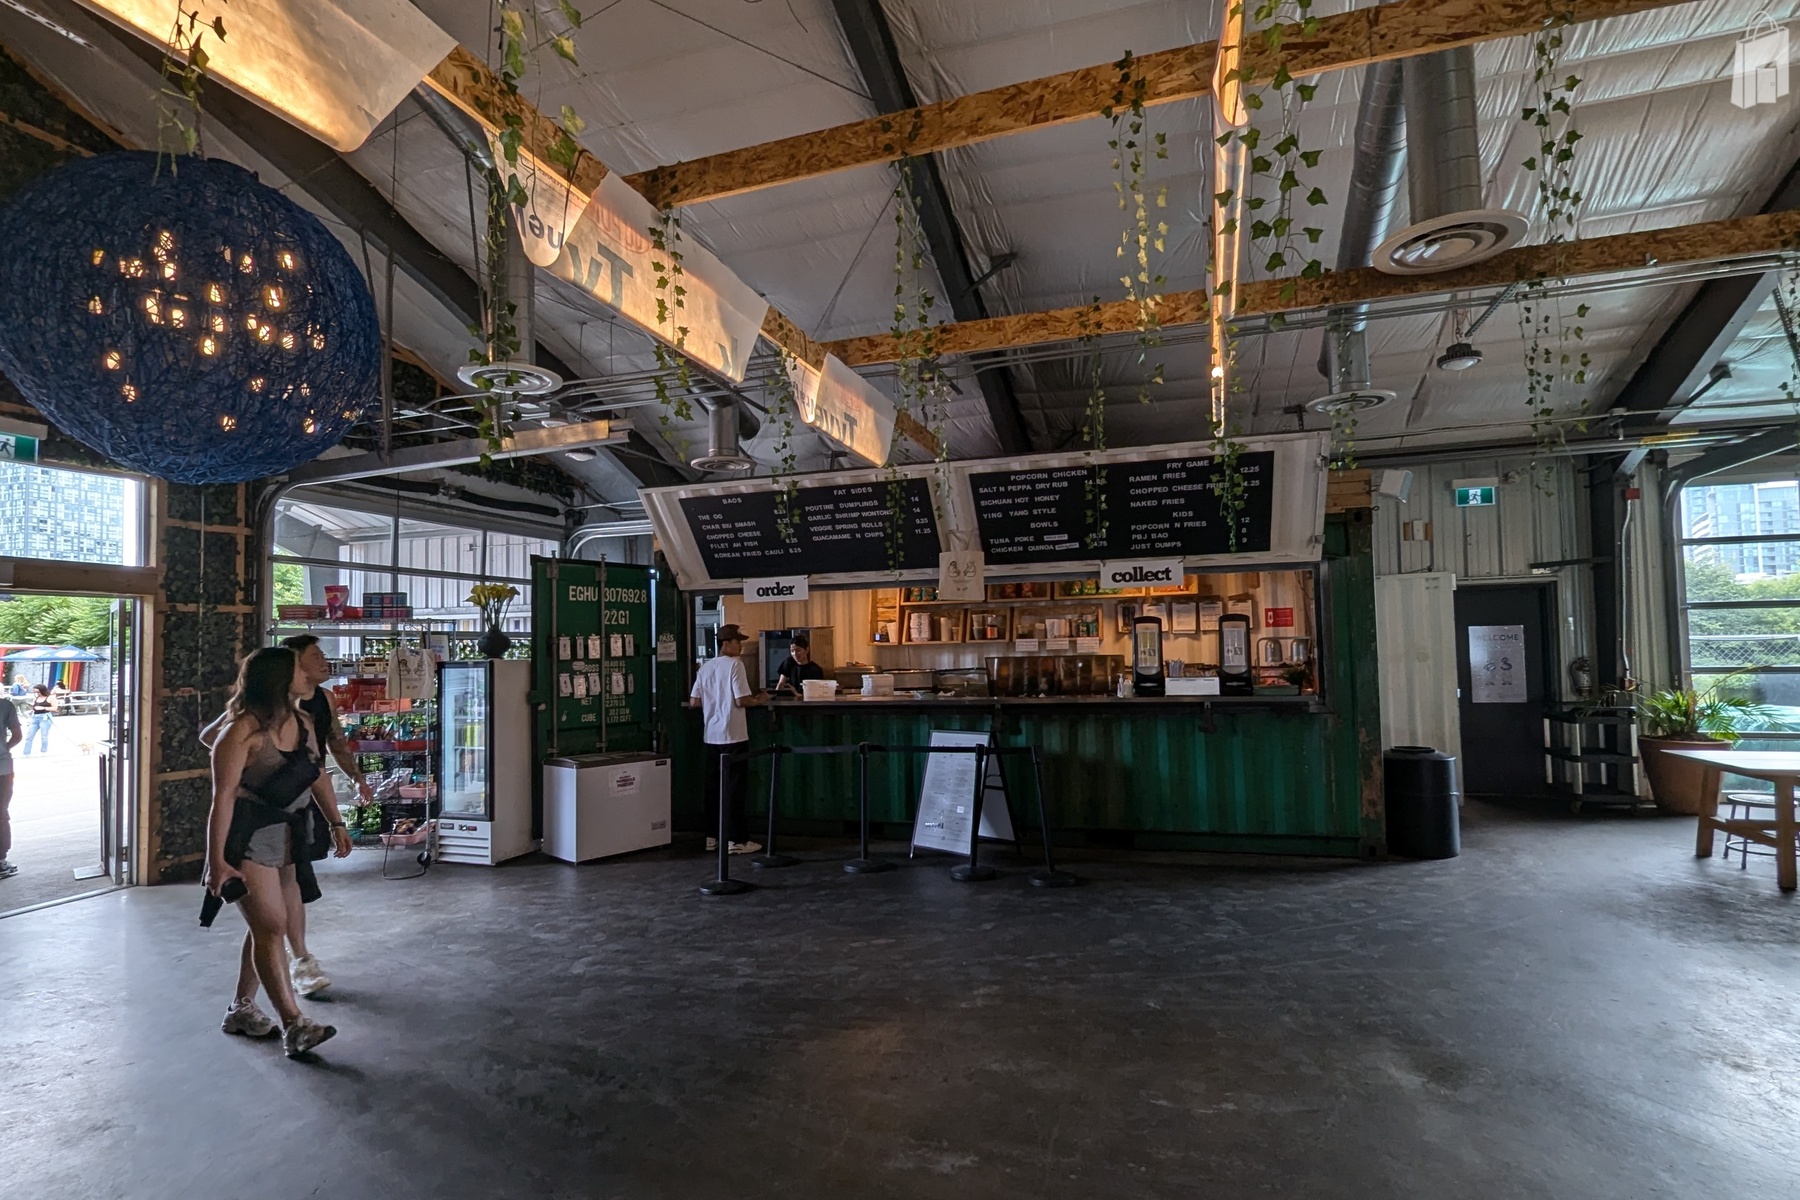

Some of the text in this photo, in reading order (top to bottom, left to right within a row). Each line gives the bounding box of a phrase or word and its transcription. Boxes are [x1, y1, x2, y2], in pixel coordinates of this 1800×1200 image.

[1052, 470, 1087, 478] CHICKEN
[805, 504, 834, 512] POUTINE
[839, 500, 878, 508] DUMPLINGS
[1112, 566, 1172, 583] collect
[569, 586, 646, 602] EGHU 3076928
[757, 582, 795, 597] order
[604, 610, 629, 624] 22G1
[582, 713, 596, 722] CUBE
